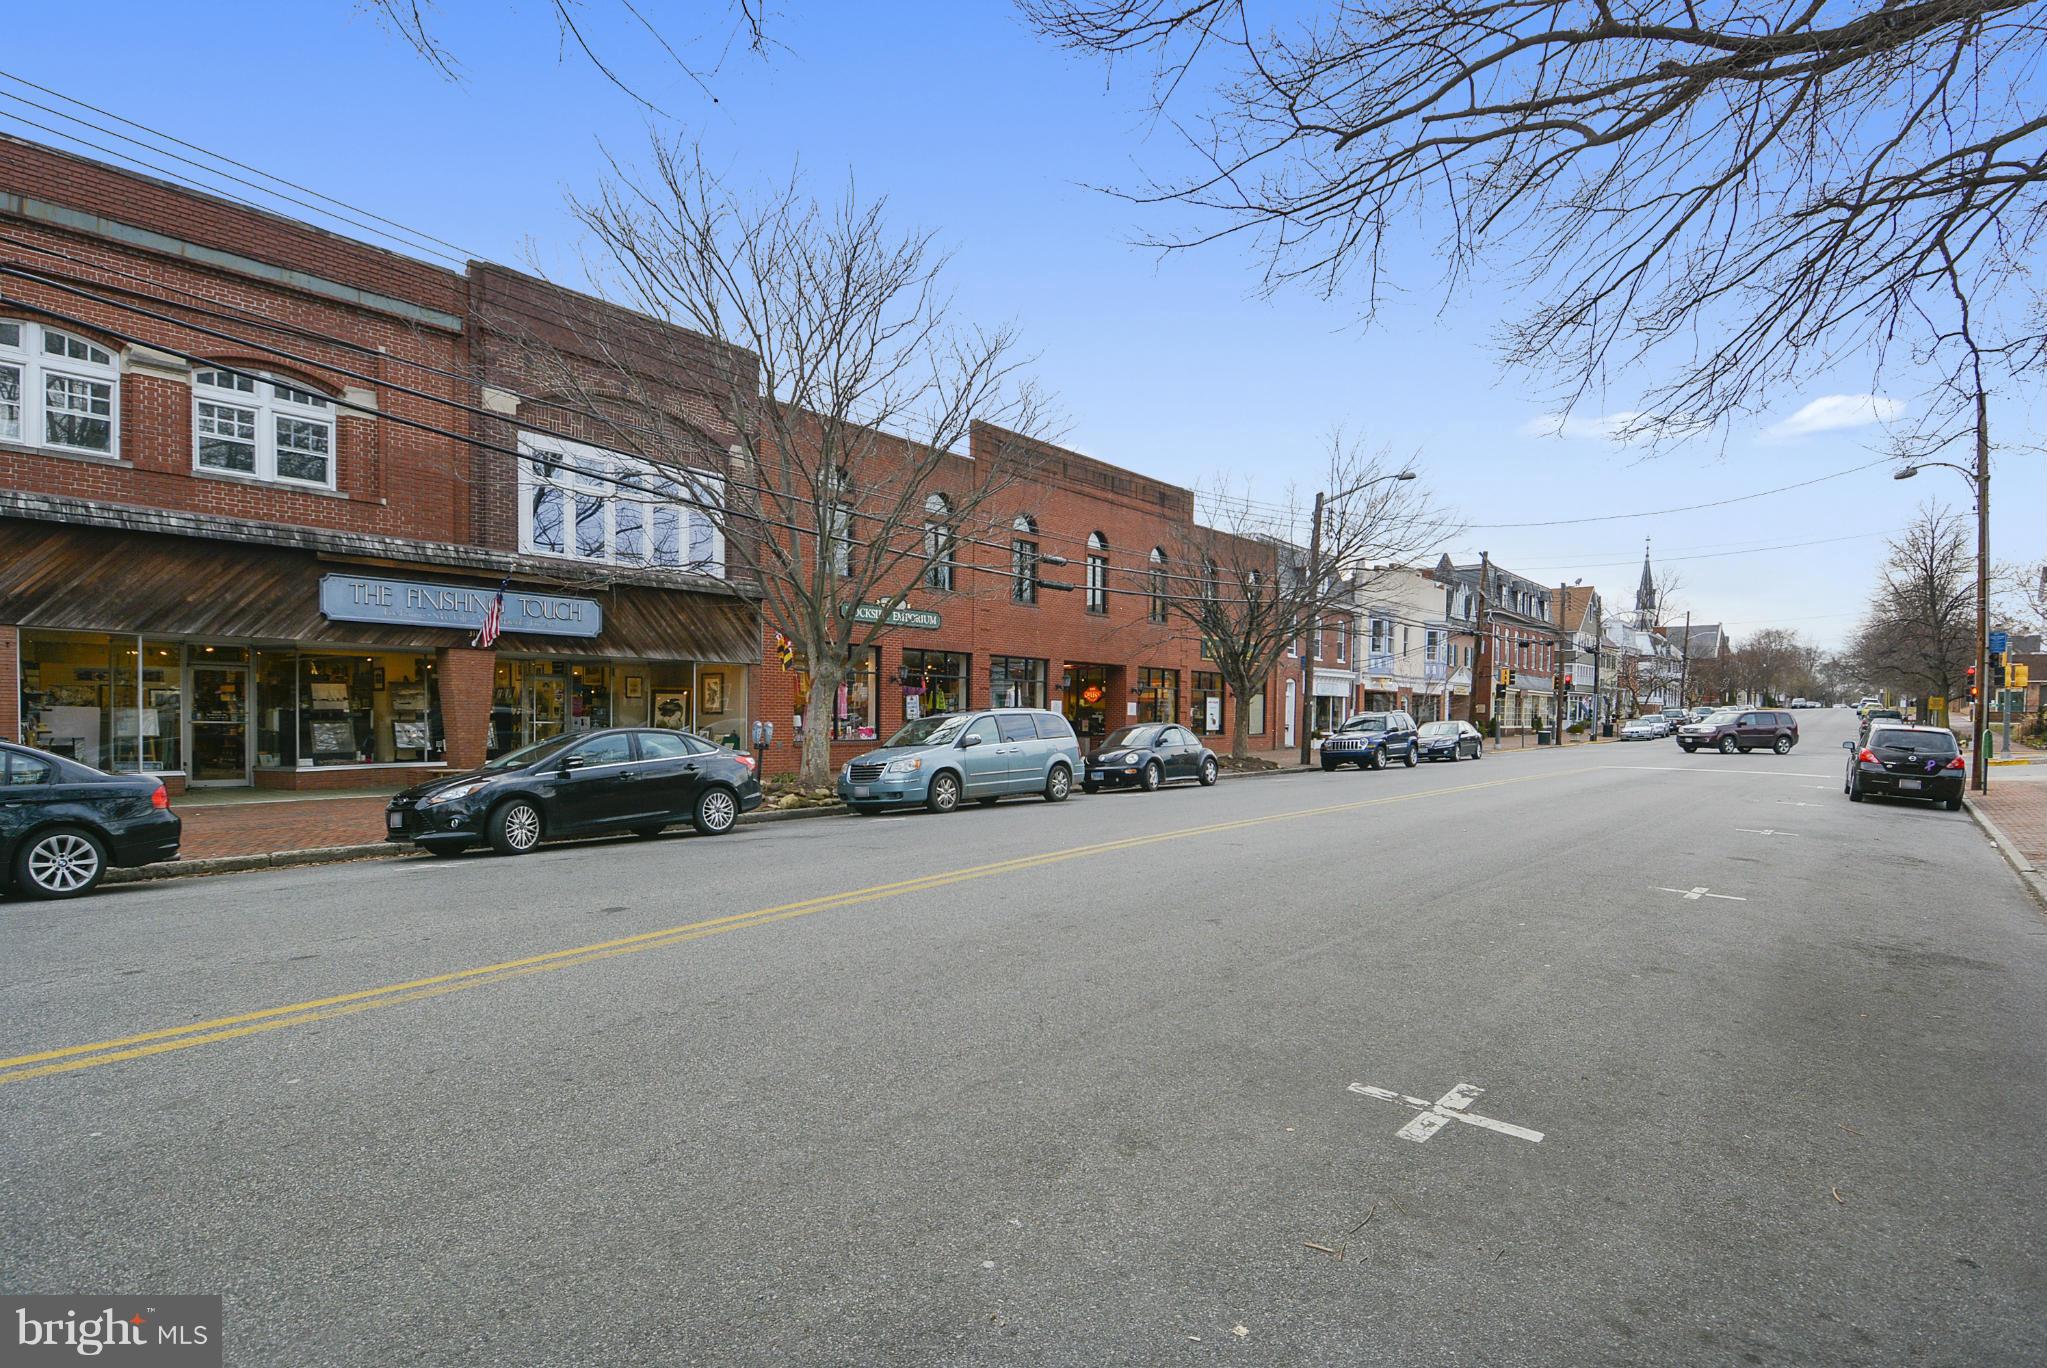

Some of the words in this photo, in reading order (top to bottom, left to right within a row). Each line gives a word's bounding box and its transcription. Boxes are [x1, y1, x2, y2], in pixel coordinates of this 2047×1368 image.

[349, 582, 393, 607] THE
[519, 598, 582, 621] TOUCH
[893, 611, 937, 625] EMPORIUM
